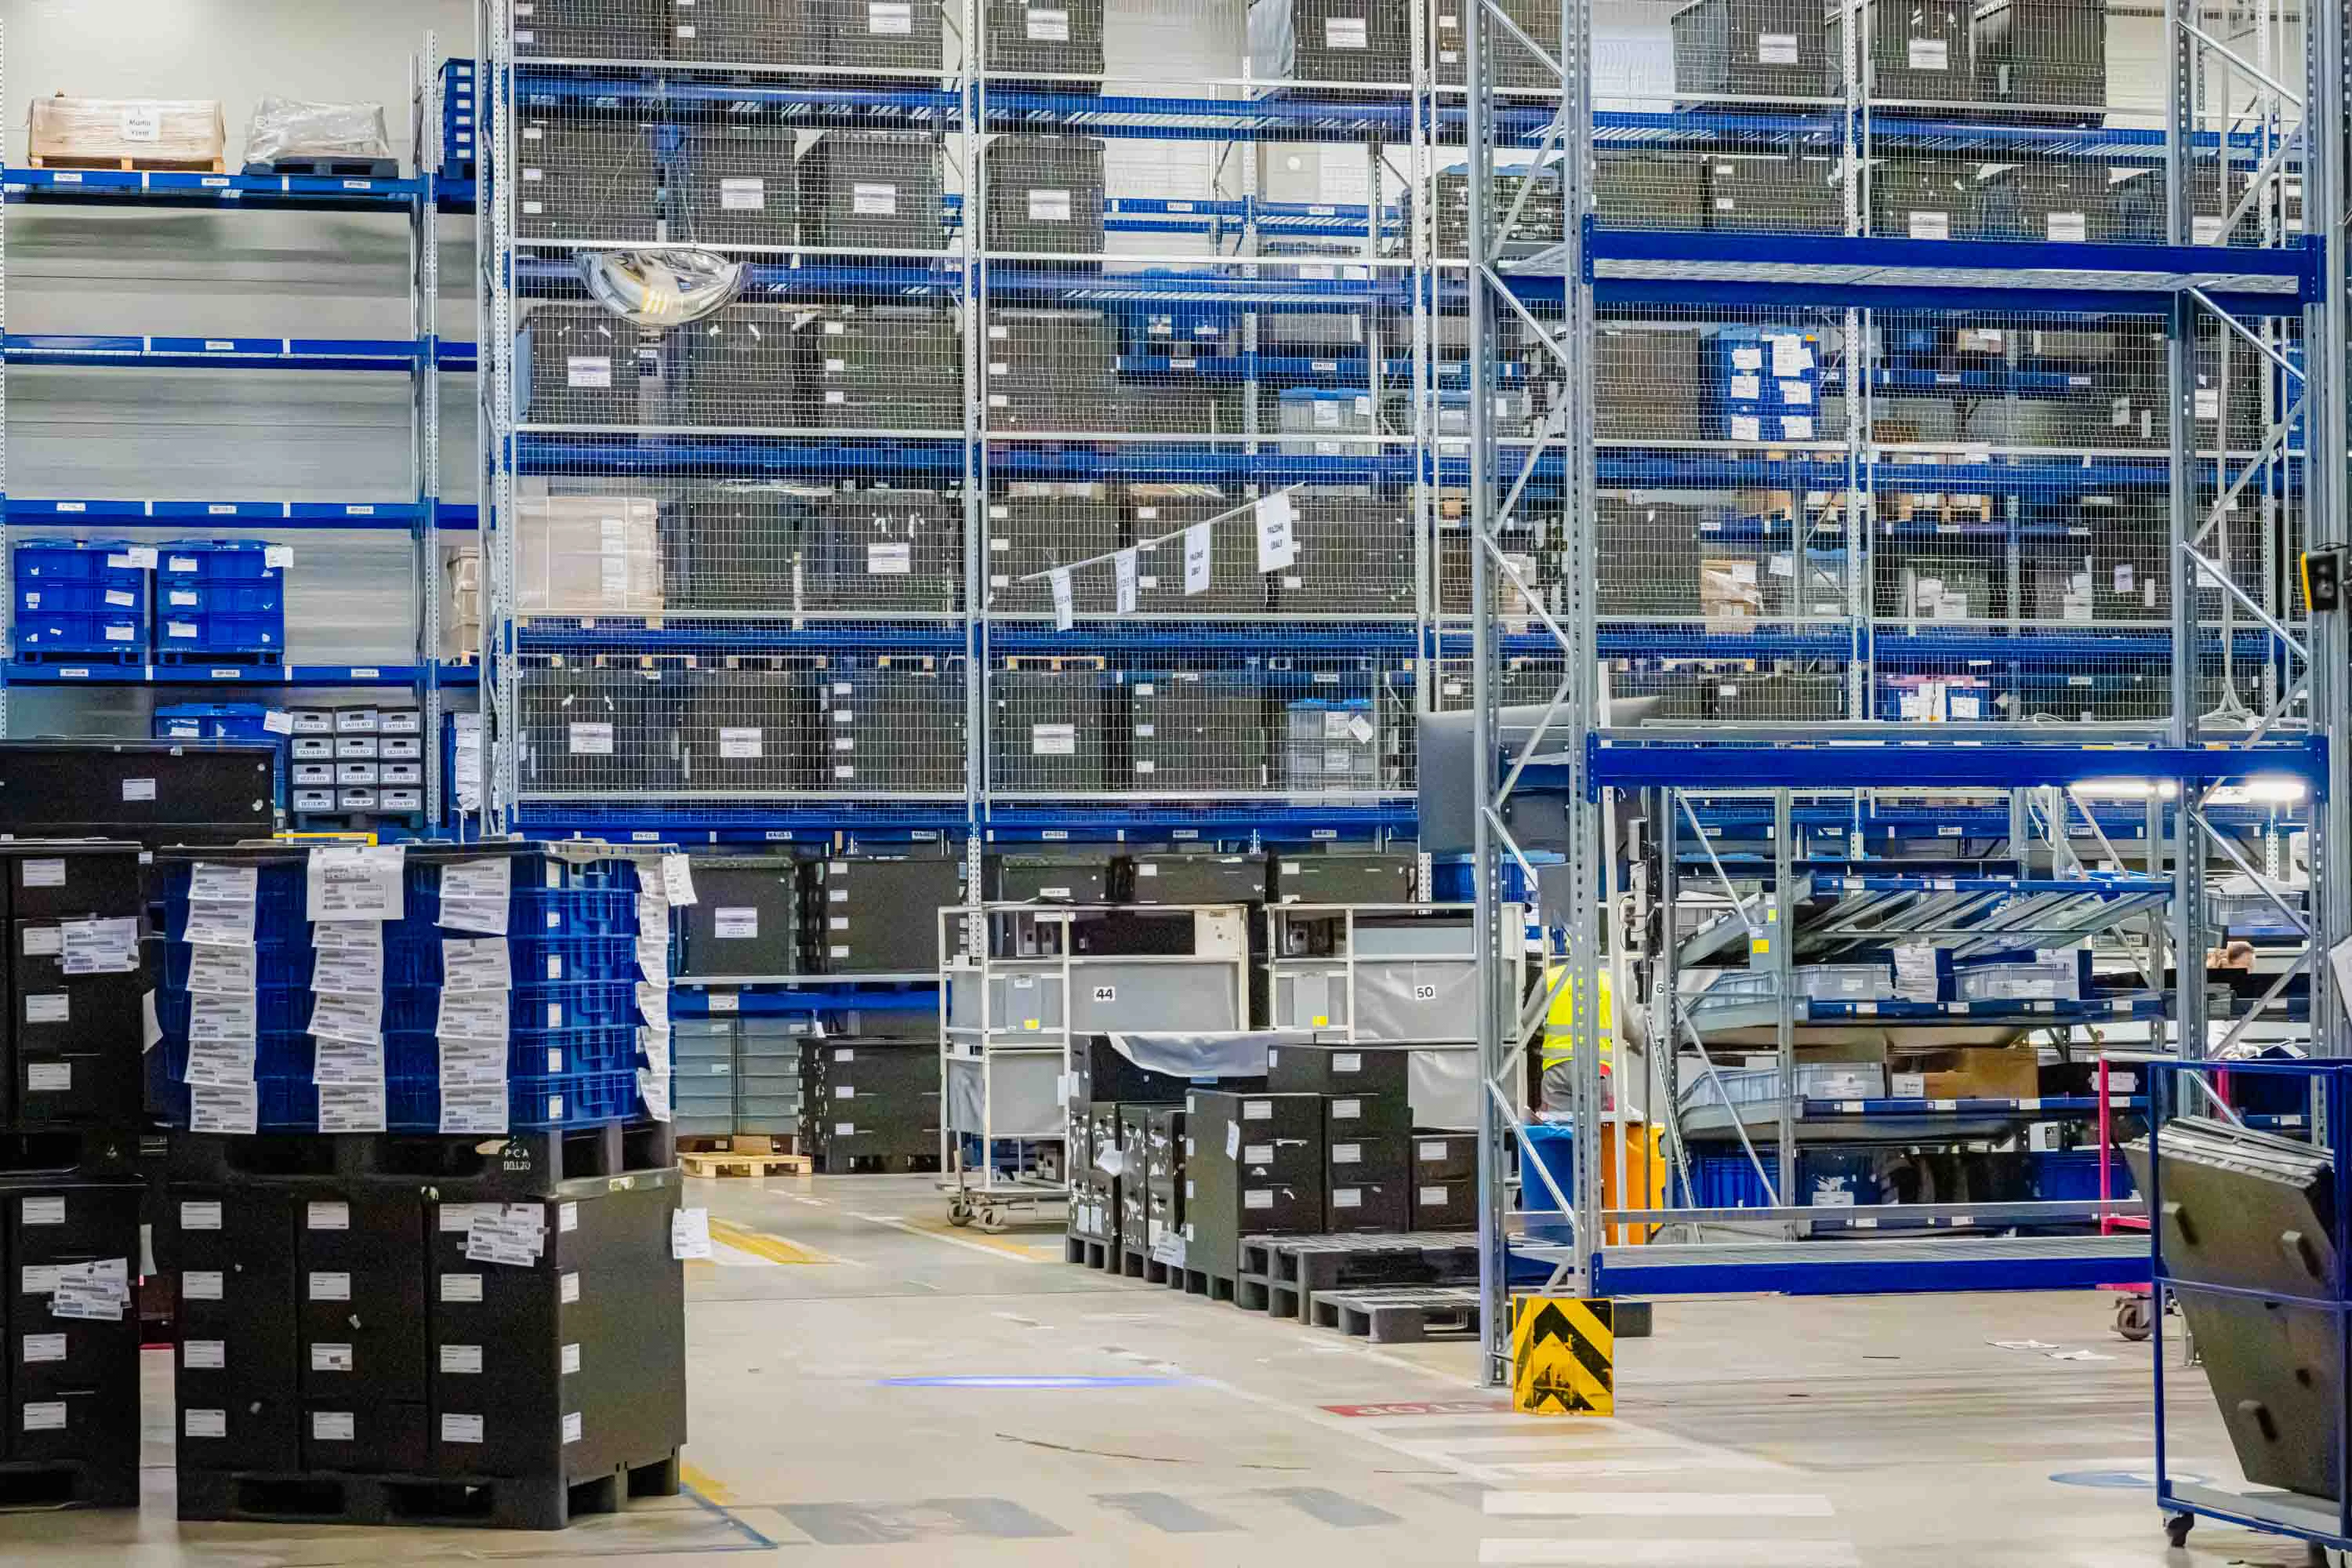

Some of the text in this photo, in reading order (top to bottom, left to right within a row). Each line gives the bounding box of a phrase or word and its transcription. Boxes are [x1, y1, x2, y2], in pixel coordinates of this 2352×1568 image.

[1096, 988, 1112, 1000] 44
[1417, 986, 1434, 998] 50
[503, 1148, 530, 1159] PCA
